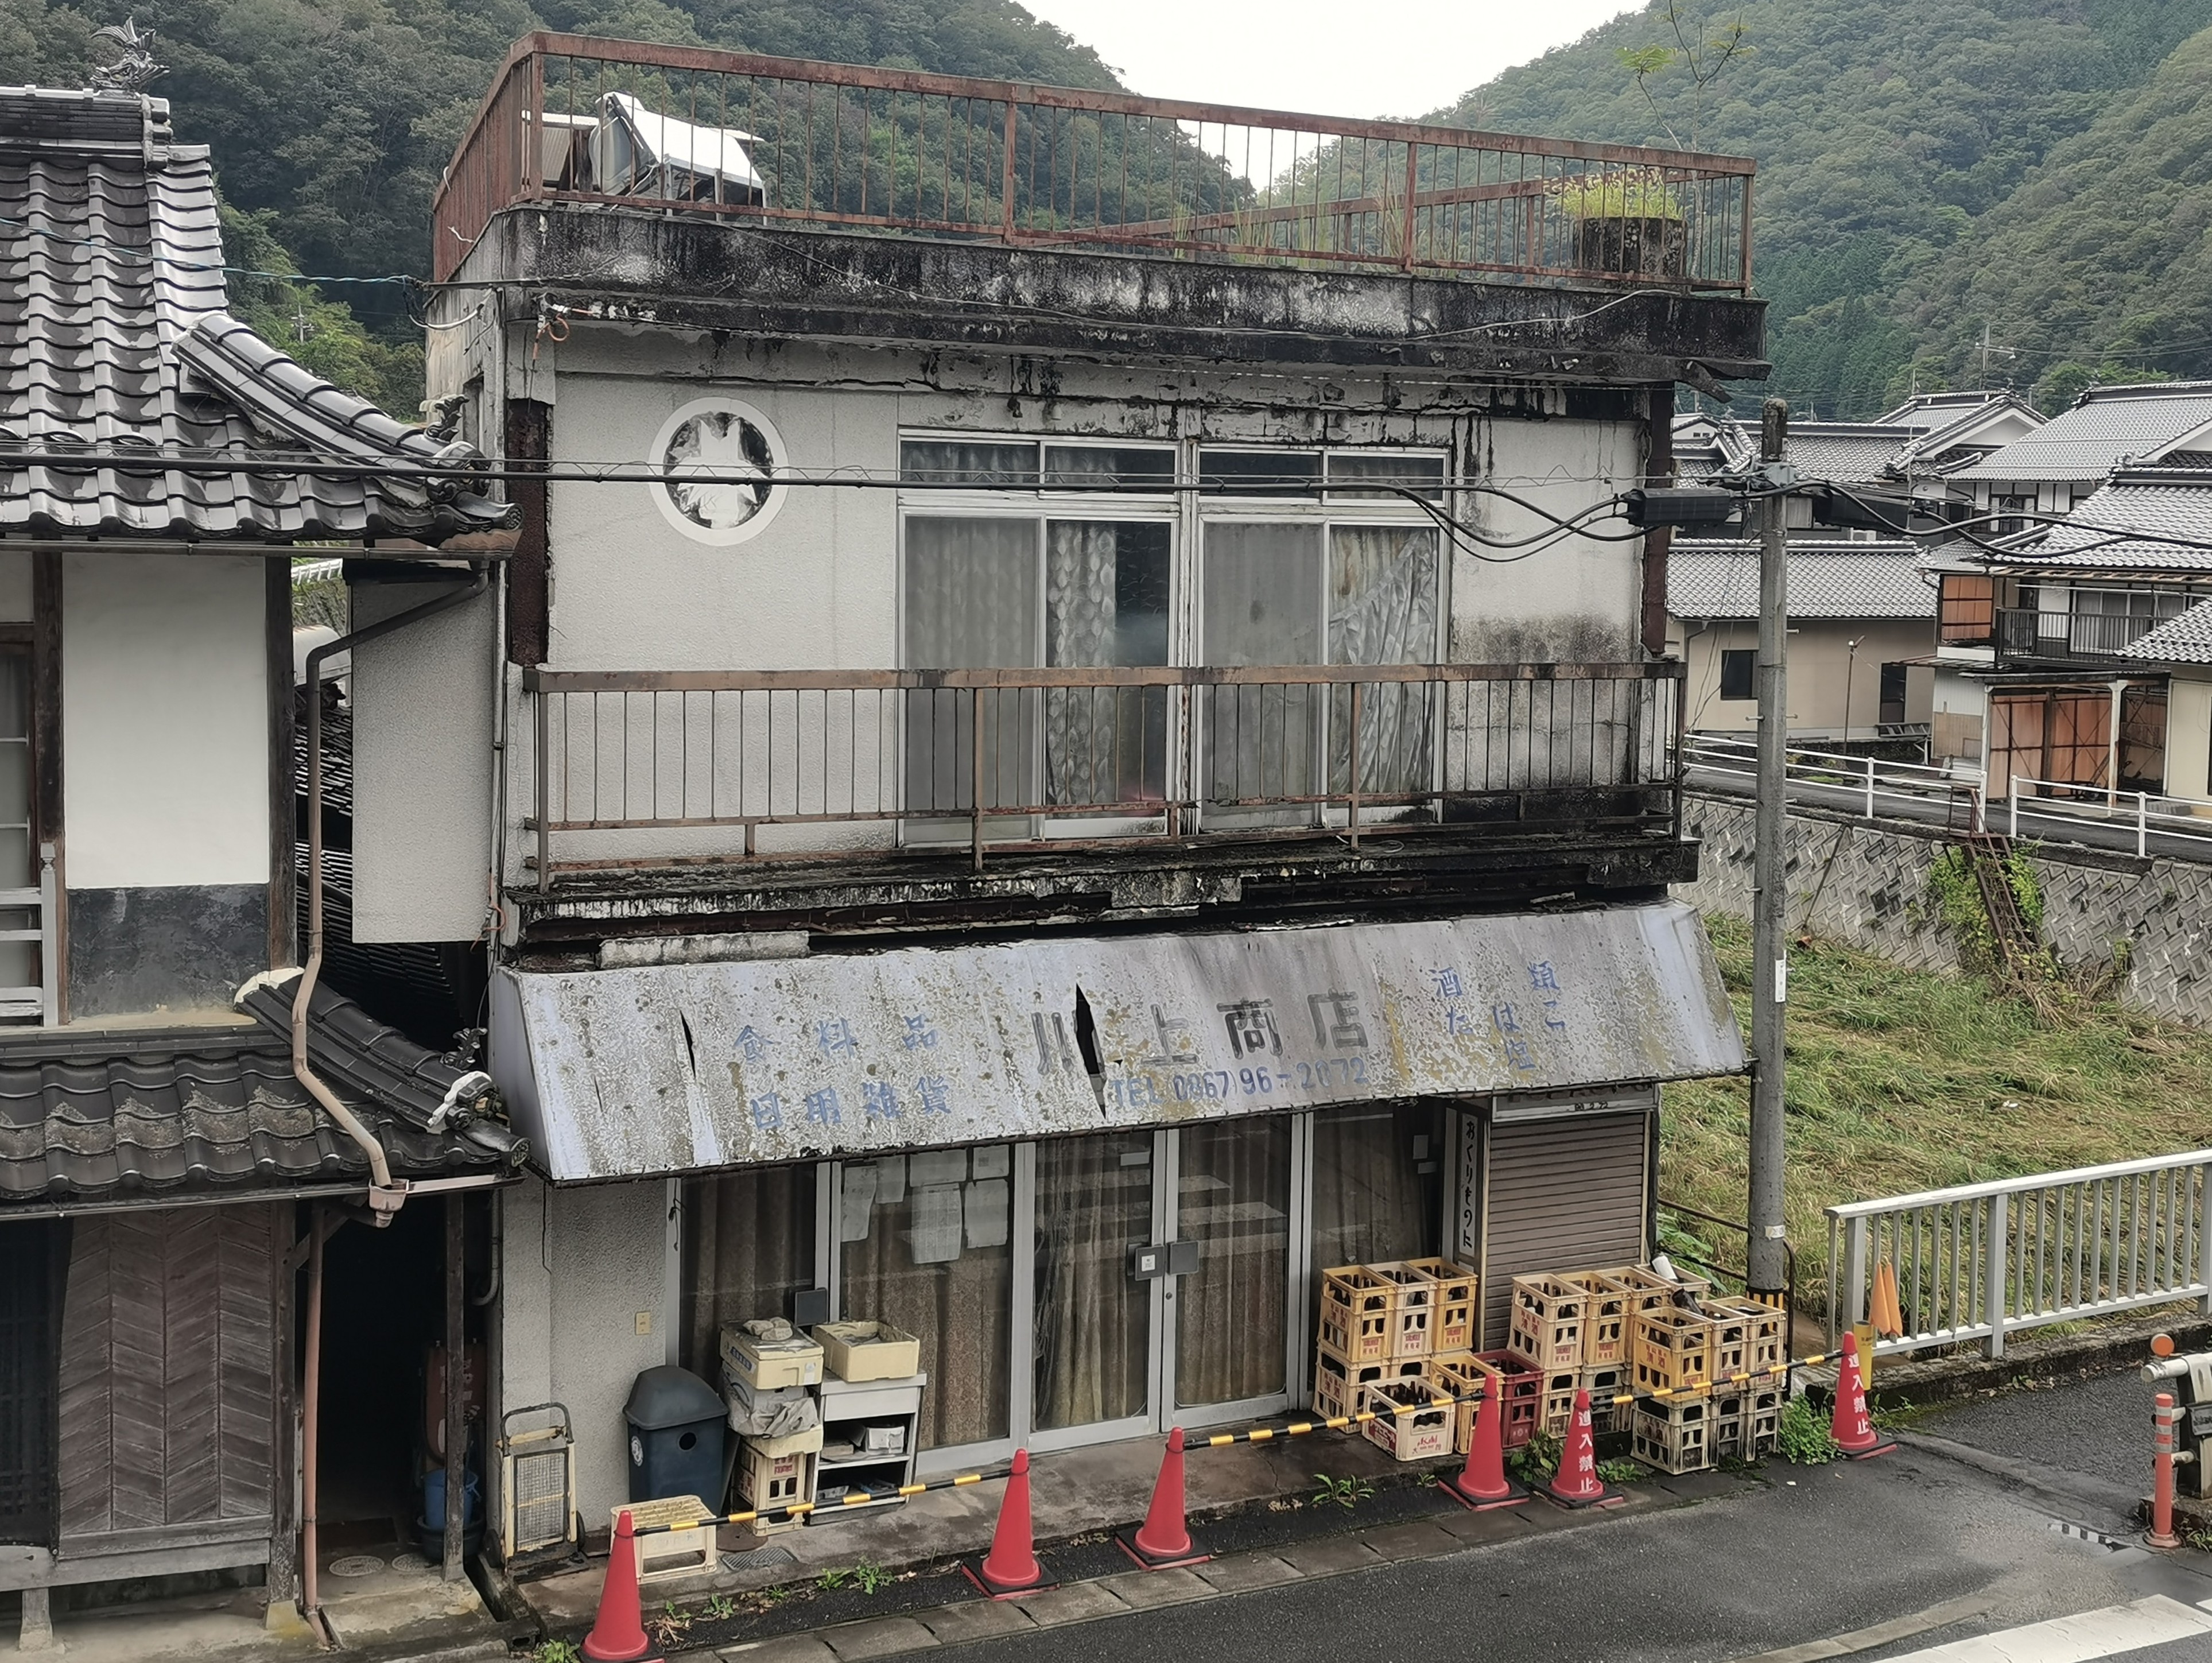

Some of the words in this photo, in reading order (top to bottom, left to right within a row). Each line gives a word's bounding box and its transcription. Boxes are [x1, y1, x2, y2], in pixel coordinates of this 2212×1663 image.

[1428, 960, 1561, 998] 酒類
[733, 1014, 940, 1062] 食料品
[1031, 988, 1368, 1076] 川上商店
[1503, 1038, 1536, 1070] 塩
[750, 1076, 952, 1130] 日用雑貨
[1109, 1075, 1163, 1107] TEL
